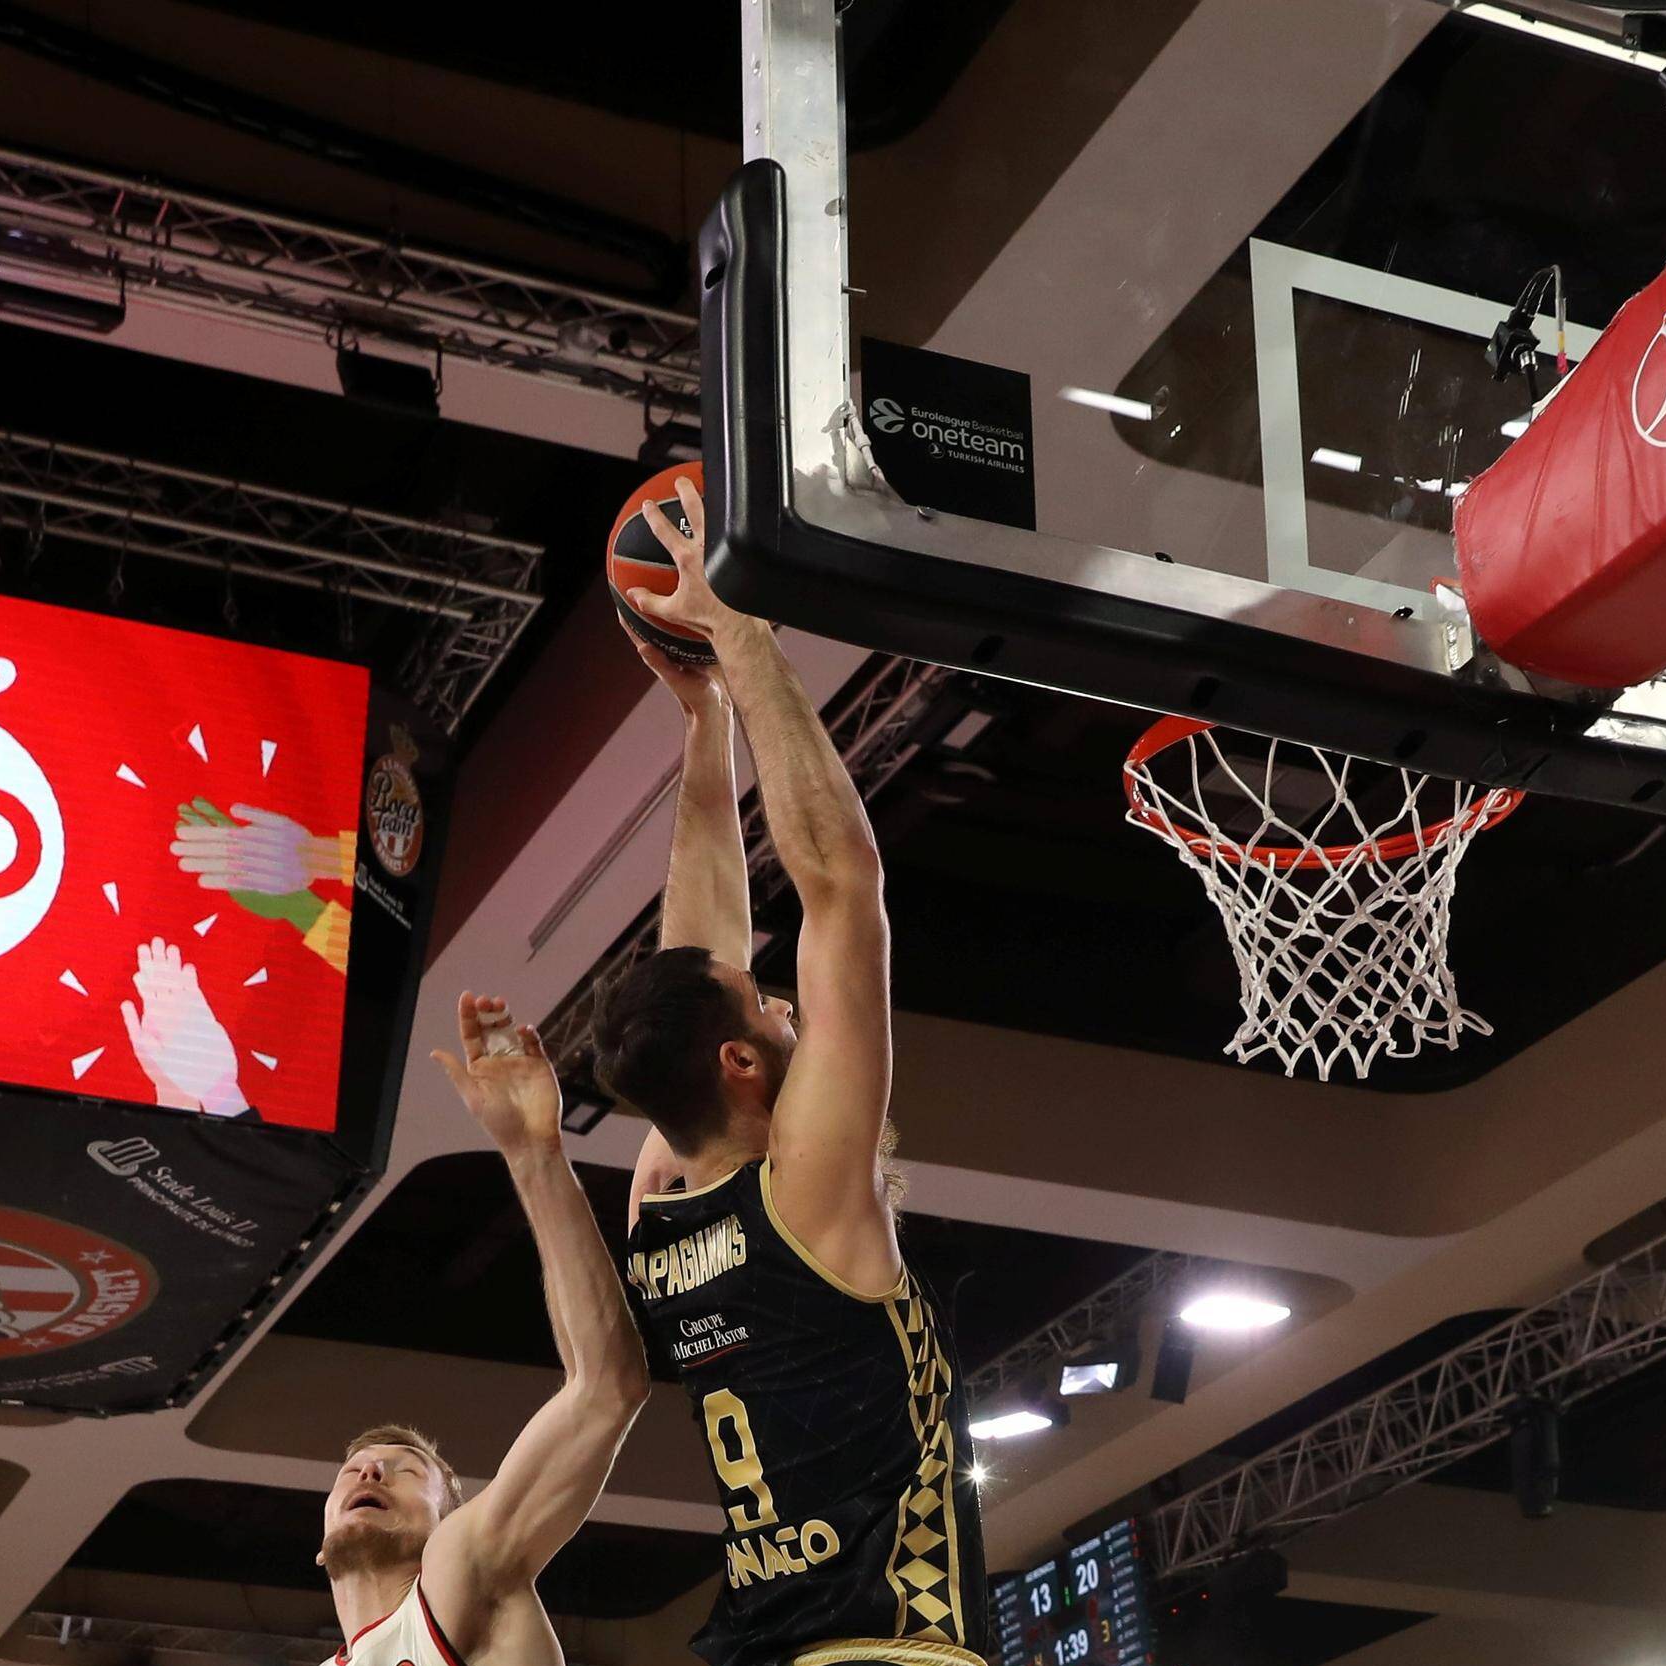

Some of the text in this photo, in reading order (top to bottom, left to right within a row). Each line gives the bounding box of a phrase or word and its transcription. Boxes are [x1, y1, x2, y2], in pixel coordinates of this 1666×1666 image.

[911, 406, 971, 429] Euroleague
[912, 422, 1024, 461] oneteam
[947, 450, 1025, 473] TURKISH AIRLINES
[49, 1268, 137, 1336] BASKET
[679, 1313, 726, 1338] GROUPE
[713, 1326, 750, 1349] PASTOR
[702, 1381, 780, 1532] 9
[1030, 1582, 1053, 1617] 13
[1075, 1558, 1100, 1596] 20
[1054, 1629, 1089, 1666] 1:39
